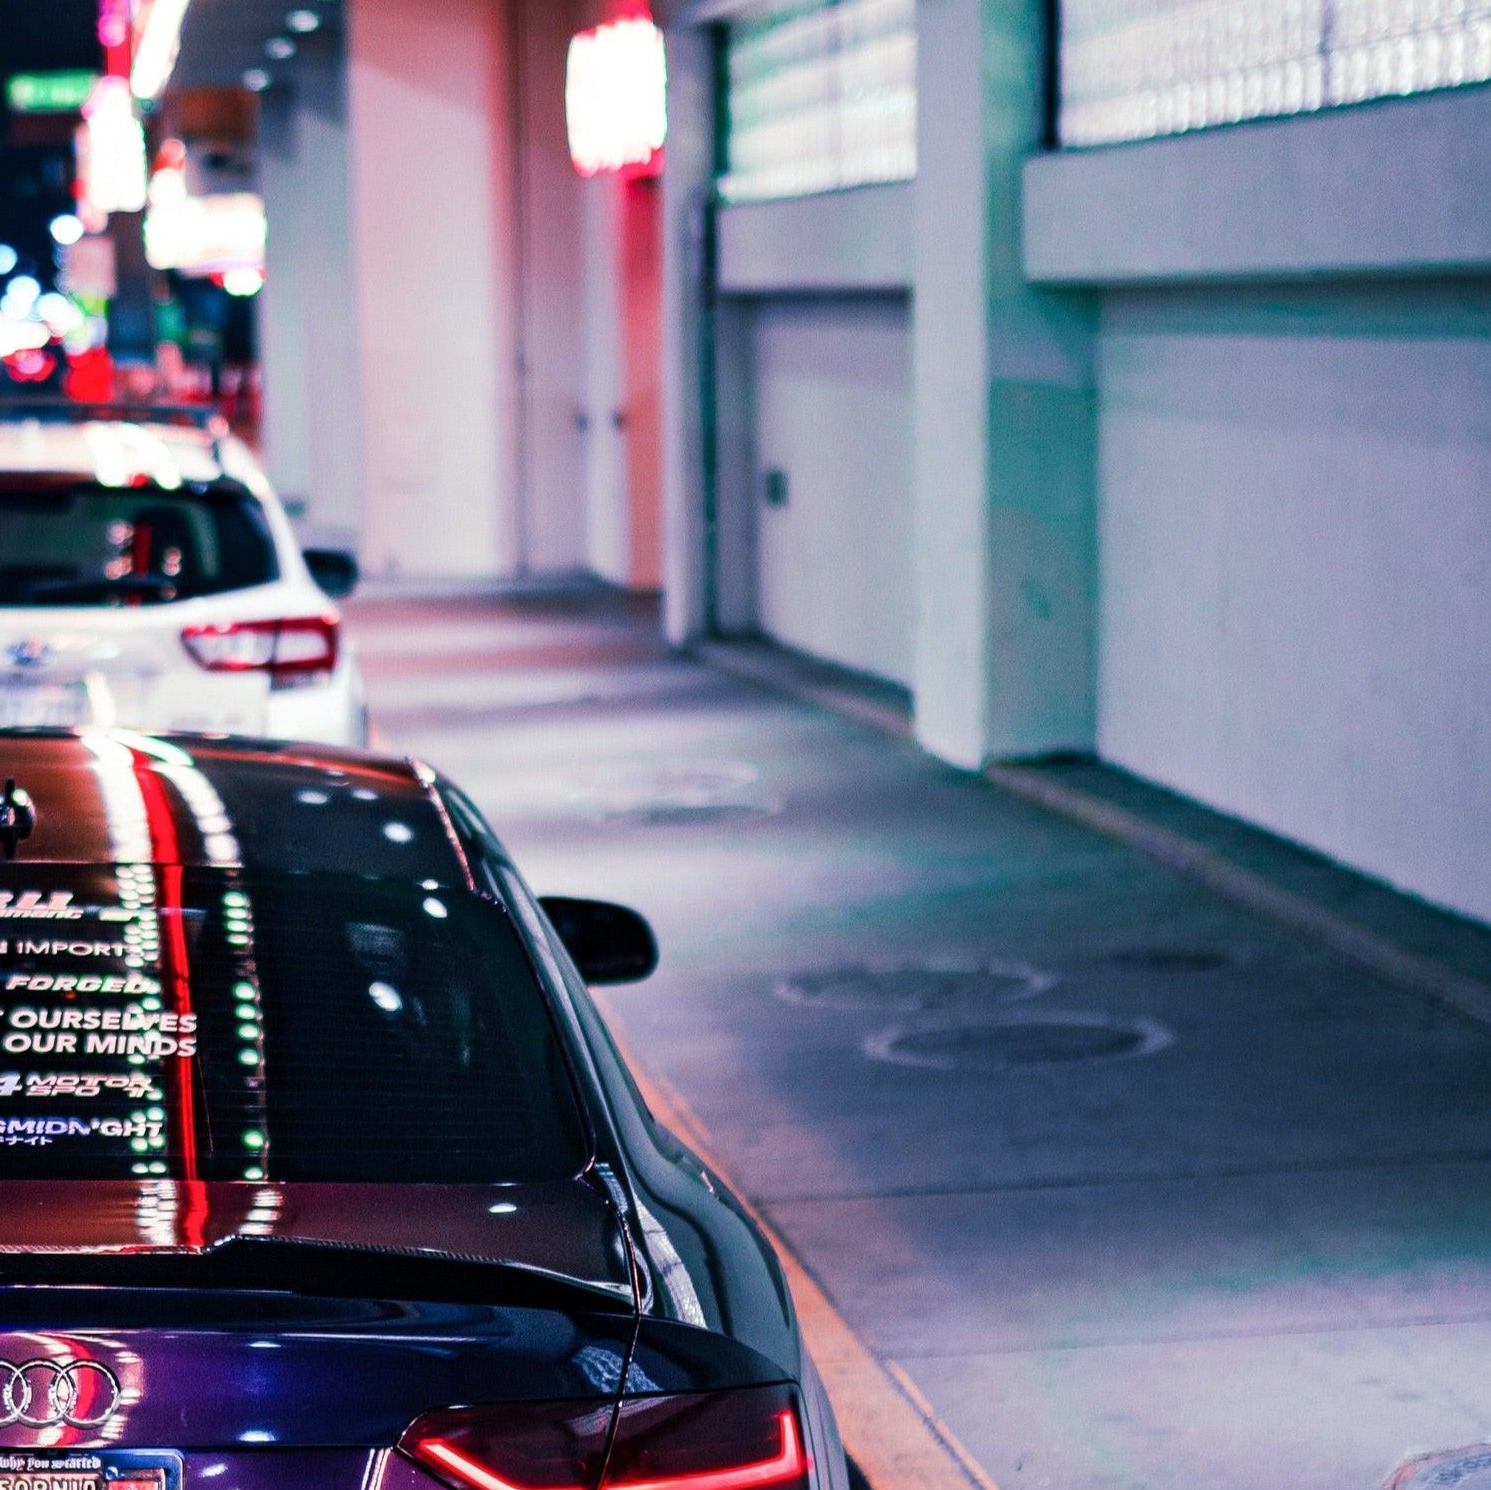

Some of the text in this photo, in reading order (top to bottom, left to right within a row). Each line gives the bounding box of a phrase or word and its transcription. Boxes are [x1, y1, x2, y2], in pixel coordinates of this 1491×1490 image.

[5, 974, 161, 994] FORGED
[12, 1009, 198, 1033] OURSELVES
[4, 1034, 78, 1054] OUR
[86, 1034, 198, 1057] MINDS
[26, 1456, 51, 1472] you
